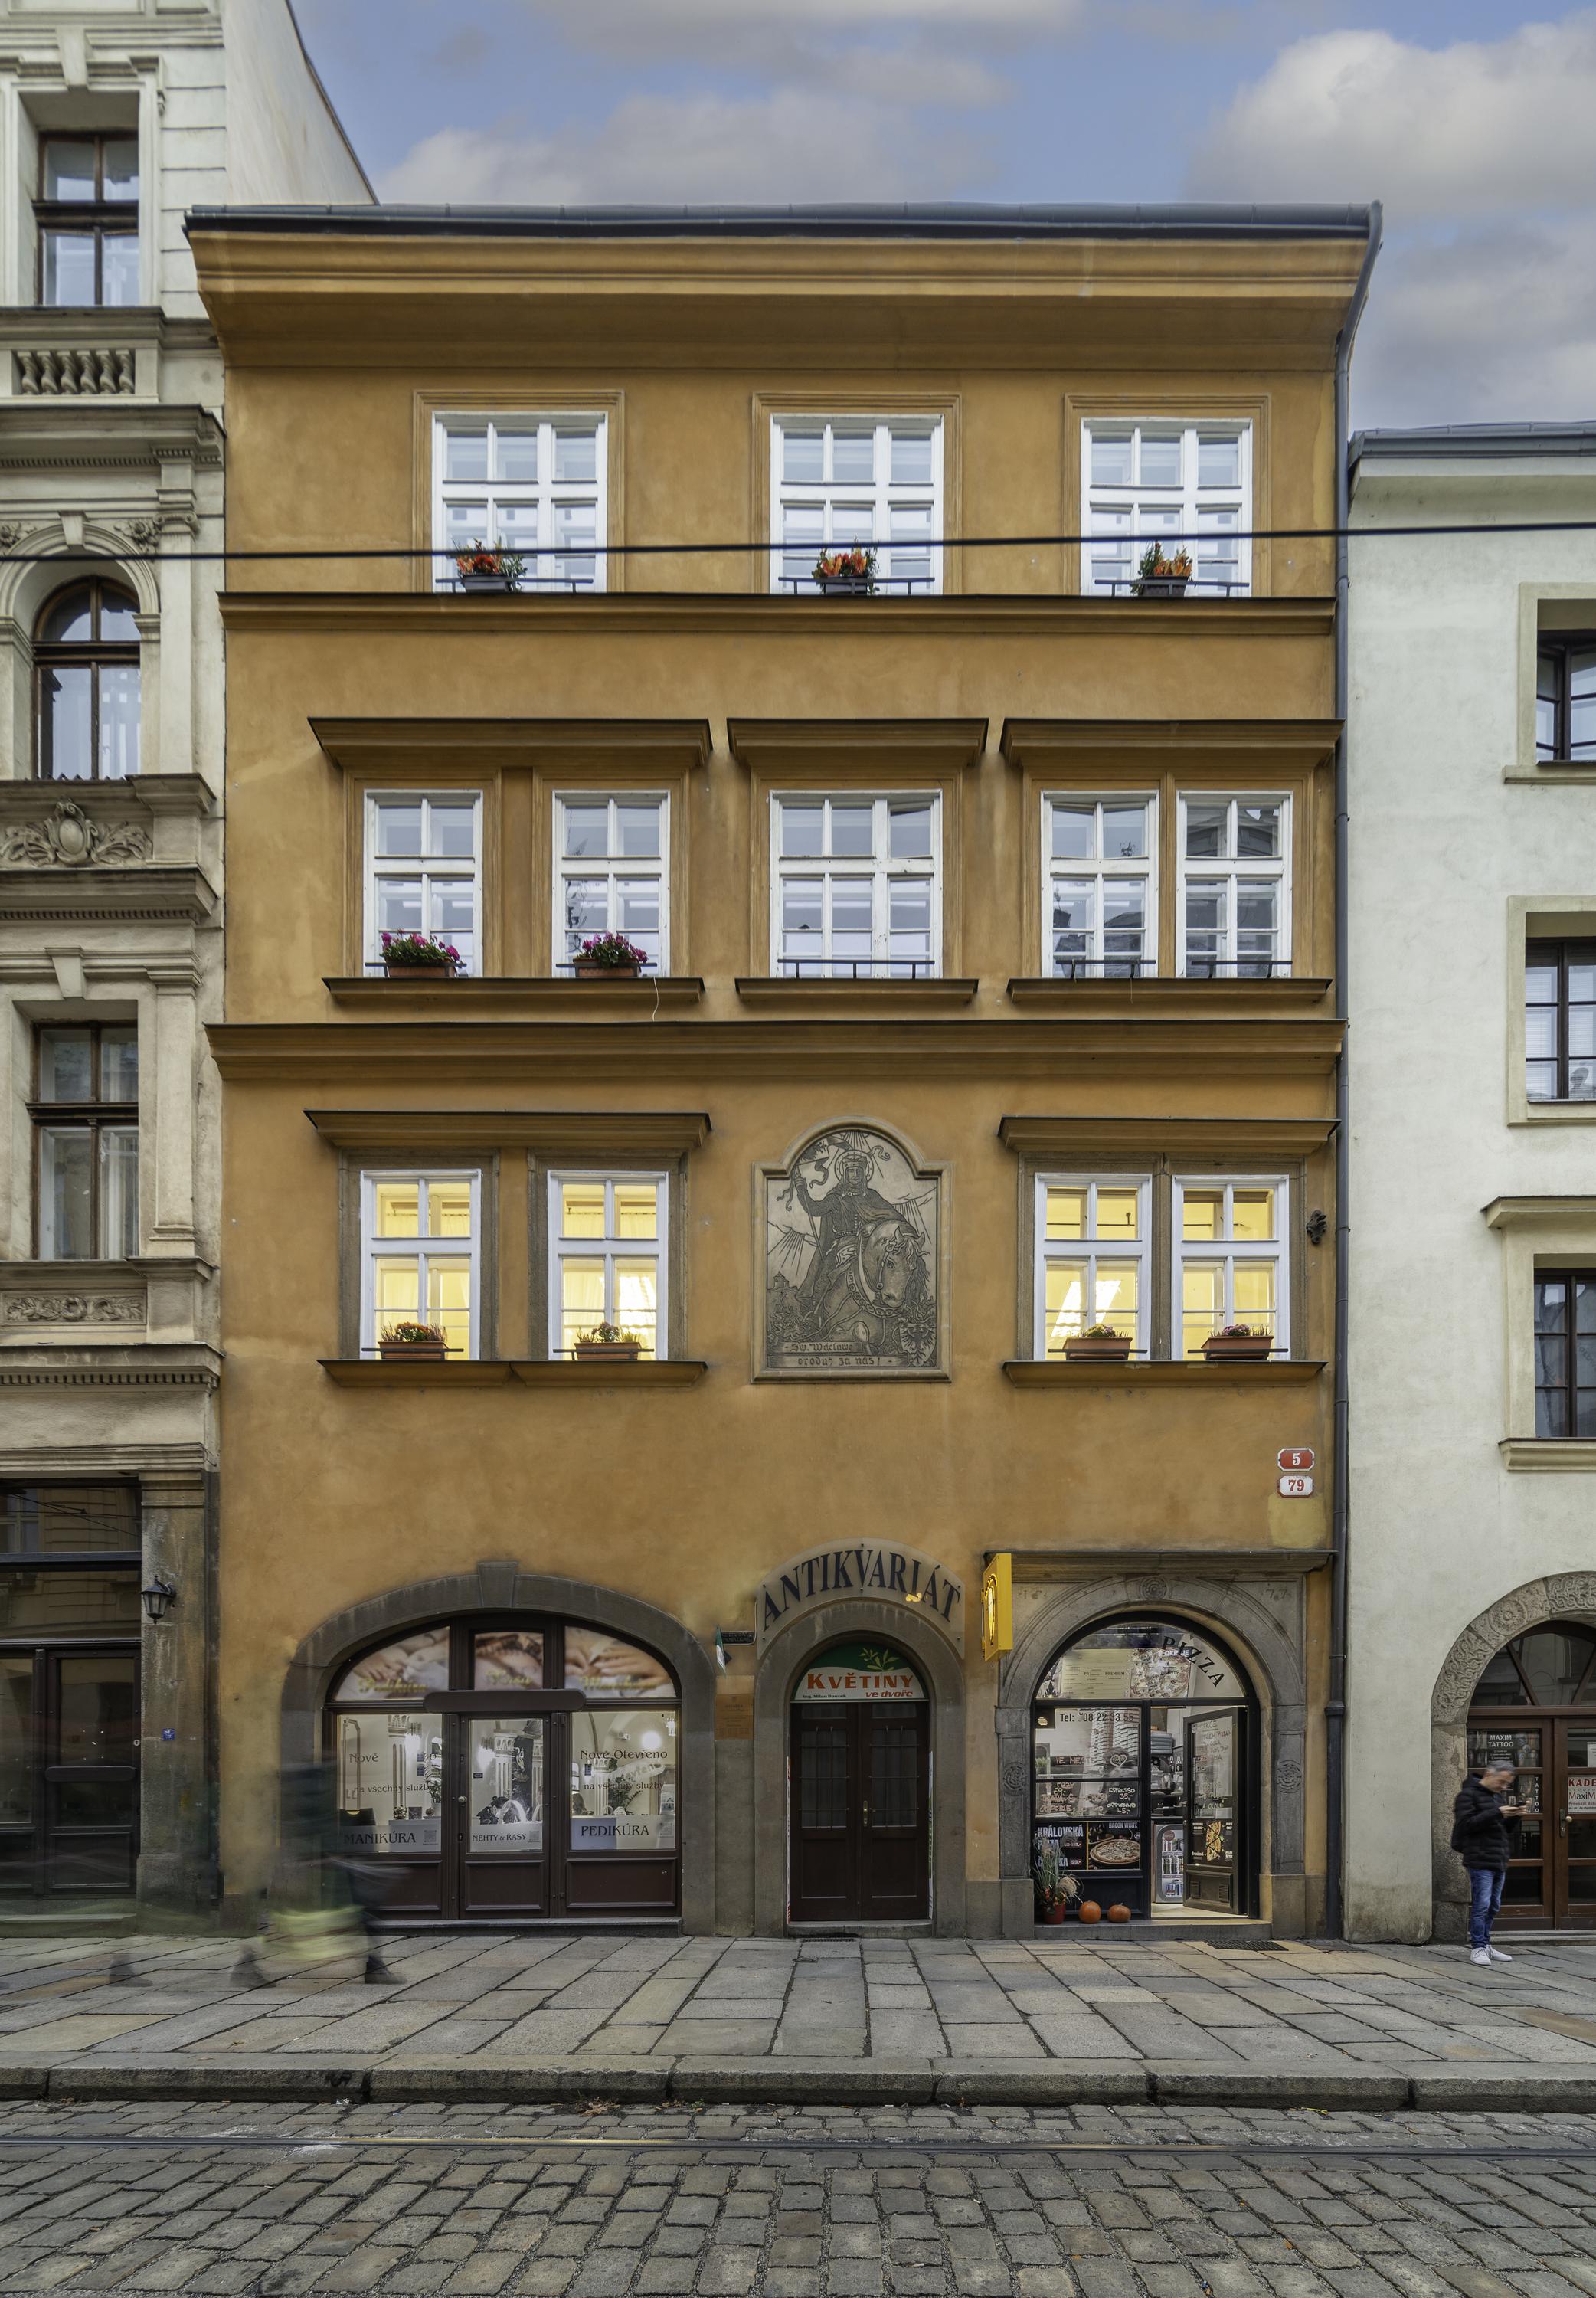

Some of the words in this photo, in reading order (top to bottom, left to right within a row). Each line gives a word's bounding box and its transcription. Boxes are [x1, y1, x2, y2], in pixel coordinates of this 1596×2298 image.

[1292, 1452, 1301, 1466] 5
[1288, 1479, 1305, 1492] 79
[763, 1549, 962, 1632] ANTIKVARIÁT
[1163, 1636, 1225, 1687] PIZZA
[807, 1672, 914, 1690] KVĚTINY
[1060, 1713, 1074, 1722] Tel:
[1097, 1712, 1107, 1722] 22
[1110, 1712, 1120, 1722] 33
[349, 1753, 379, 1763] Nově
[613, 1750, 668, 1760] Otevřeno
[368, 1784, 403, 1794] všechny
[406, 1783, 432, 1792] služb
[581, 1823, 649, 1837] PEDIKÚRA
[344, 1830, 417, 1845] MANIKÚRA
[473, 1834, 499, 1842] NEHTY
